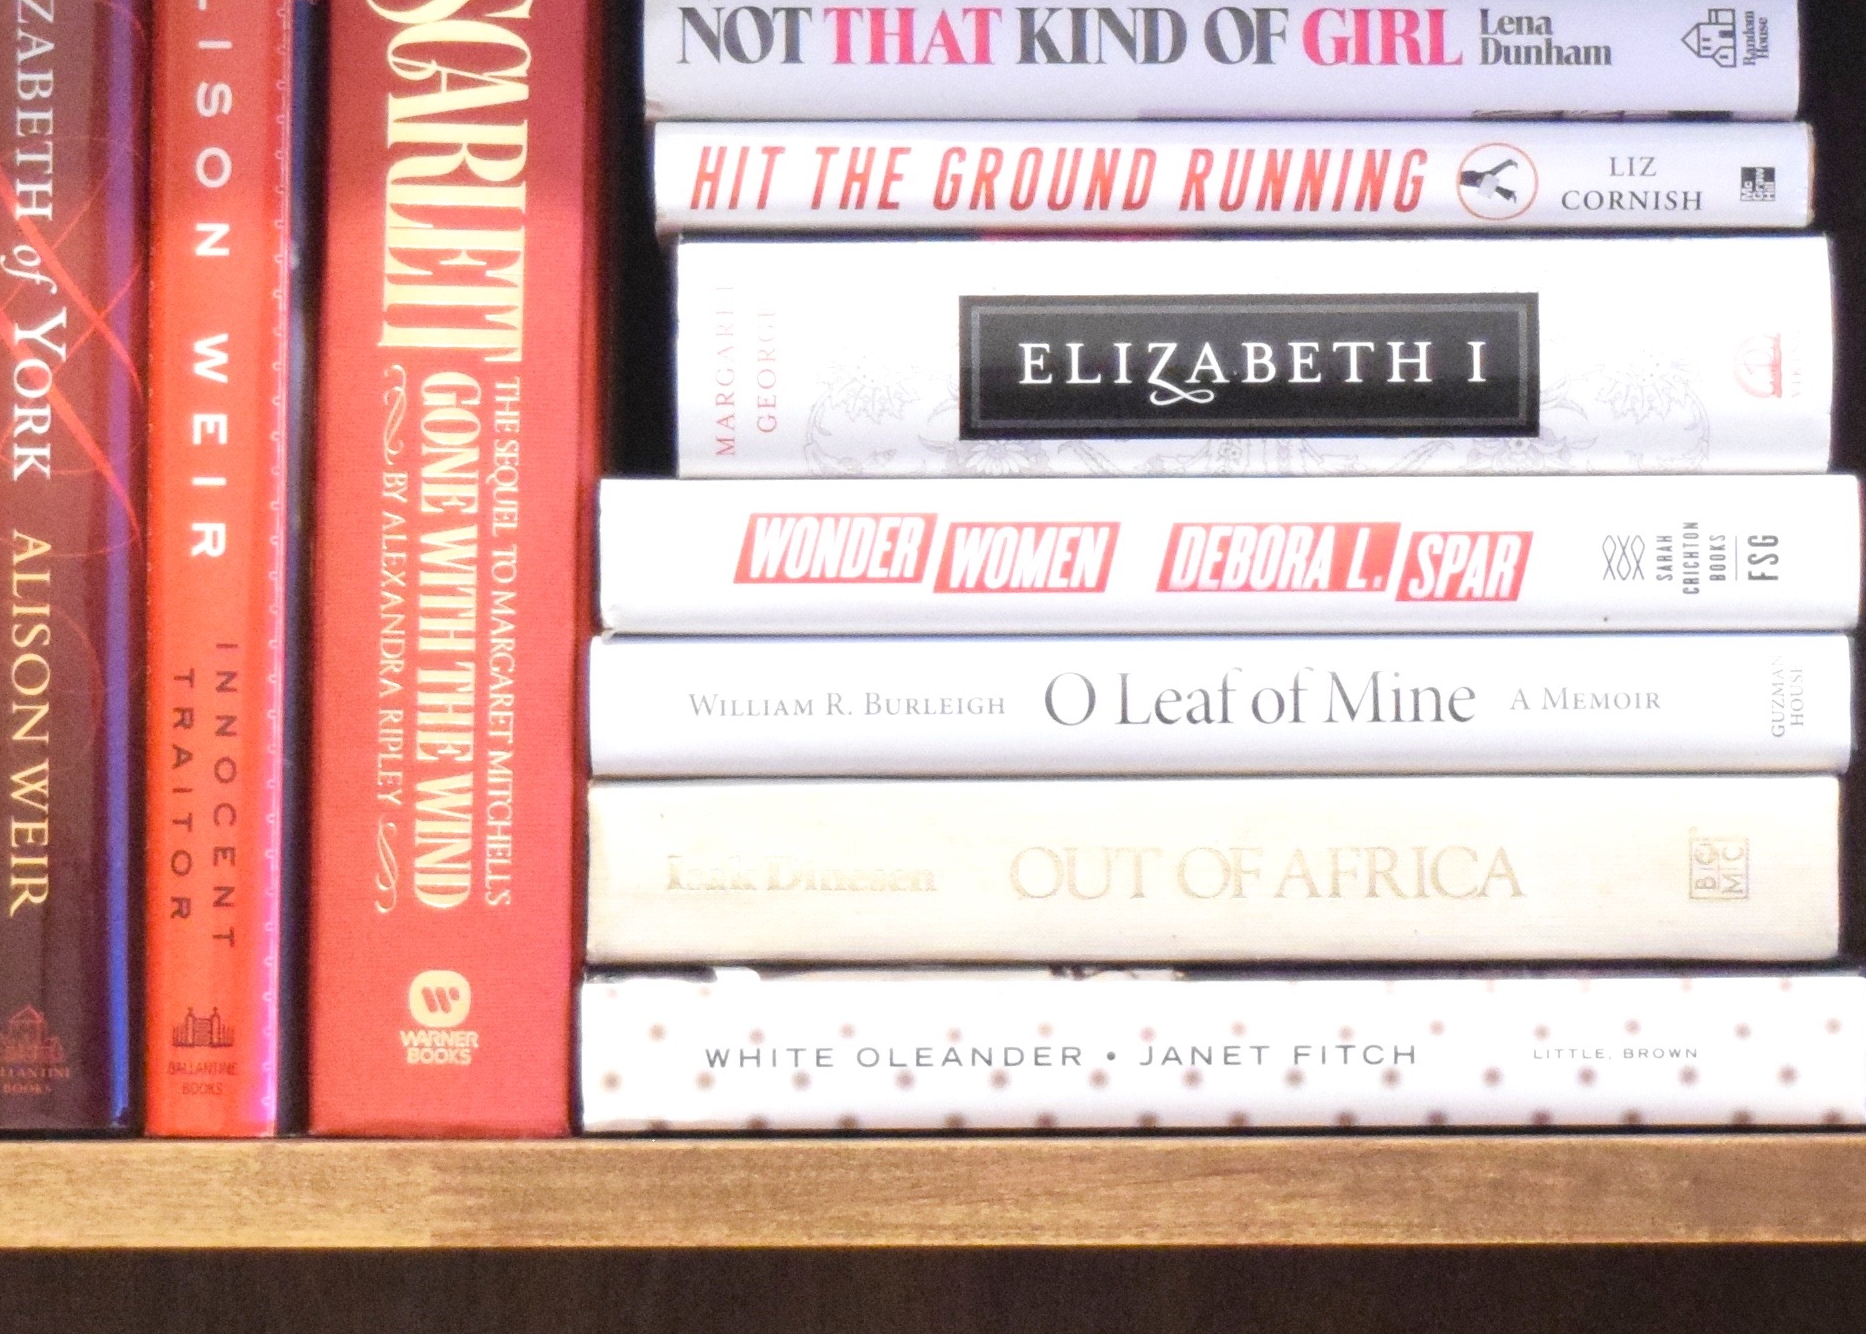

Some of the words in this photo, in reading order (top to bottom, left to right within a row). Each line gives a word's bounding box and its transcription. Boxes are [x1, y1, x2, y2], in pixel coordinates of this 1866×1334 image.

[676, 6, 813, 65] NOT
[823, 7, 1003, 65] THAT
[1014, 6, 1187, 65] KIND
[1203, 6, 1289, 65] OF
[1302, 7, 1463, 67] GIRL
[1479, 9, 1553, 36] Lena
[1479, 37, 1613, 66] Dunham
[1742, 10, 1756, 67] Random
[1756, 16, 1769, 60] House
[689, 146, 786, 210] HIT
[810, 146, 912, 211] THE
[931, 146, 1158, 211] GROUND
[1178, 148, 1428, 213] RUNNING
[1609, 155, 1658, 178] LIZ
[1560, 189, 1703, 211] CORNISH
[0, 245, 57, 296] of
[14, 306, 67, 481] YORK
[1018, 341, 1432, 406] ELIZABETH
[1467, 341, 1488, 383] I
[493, 375, 522, 434] THE
[190, 332, 232, 559] WEIR
[421, 371, 483, 515] GONE
[381, 469, 410, 503] BY
[485, 438, 520, 538] SEQUEL
[489, 543, 517, 582] TO
[749, 517, 932, 580] WONDER
[944, 526, 1112, 590] WOMEN
[1169, 524, 1338, 591] DEBORA
[1346, 526, 1385, 590] L.
[1408, 535, 1527, 599] SPAR
[1657, 534, 1673, 582] SARAH
[1683, 521, 1699, 595] CRICHTON
[1709, 533, 1726, 582] BOOKS
[1747, 534, 1778, 582] FSG
[379, 509, 408, 698] ALEXANDRA
[417, 522, 479, 655] WITH
[11, 528, 51, 746] ALISON
[486, 588, 517, 741] MARGARET
[415, 660, 477, 762] THE
[688, 693, 814, 717] WILLIAM
[826, 694, 854, 716] R.
[864, 692, 1006, 716] BURLEIGH
[1044, 672, 1096, 725] O
[1113, 667, 1243, 725] Leaf
[1251, 667, 1316, 723] of
[1321, 670, 1477, 723] Mine
[1509, 689, 1531, 711] A
[1541, 688, 1662, 711] MEMOIR
[1770, 655, 1785, 738] GUZMAN
[376, 709, 404, 807] RIPLEY
[170, 669, 195, 921] TRAITOR
[211, 643, 239, 948] INNOCENT
[9, 762, 51, 918] WEIR
[414, 771, 473, 909] WIND
[1011, 846, 1161, 900] OUT
[1177, 845, 1265, 900] OF
[1273, 846, 1527, 899] AFRICA
[167, 1061, 239, 1075] BALLANTINE
[400, 1029, 479, 1049] WARNER
[406, 1048, 471, 1065] BOOKS
[705, 1047, 833, 1068] WHITE
[857, 1046, 1083, 1067] OLEANDER
[1139, 1045, 1270, 1067] JANET
[1294, 1044, 1416, 1066] FITCH
[1533, 1048, 1613, 1061] LITTLE,
[1623, 1047, 1699, 1059] BROWN
[182, 1082, 223, 1095] BOOKS
